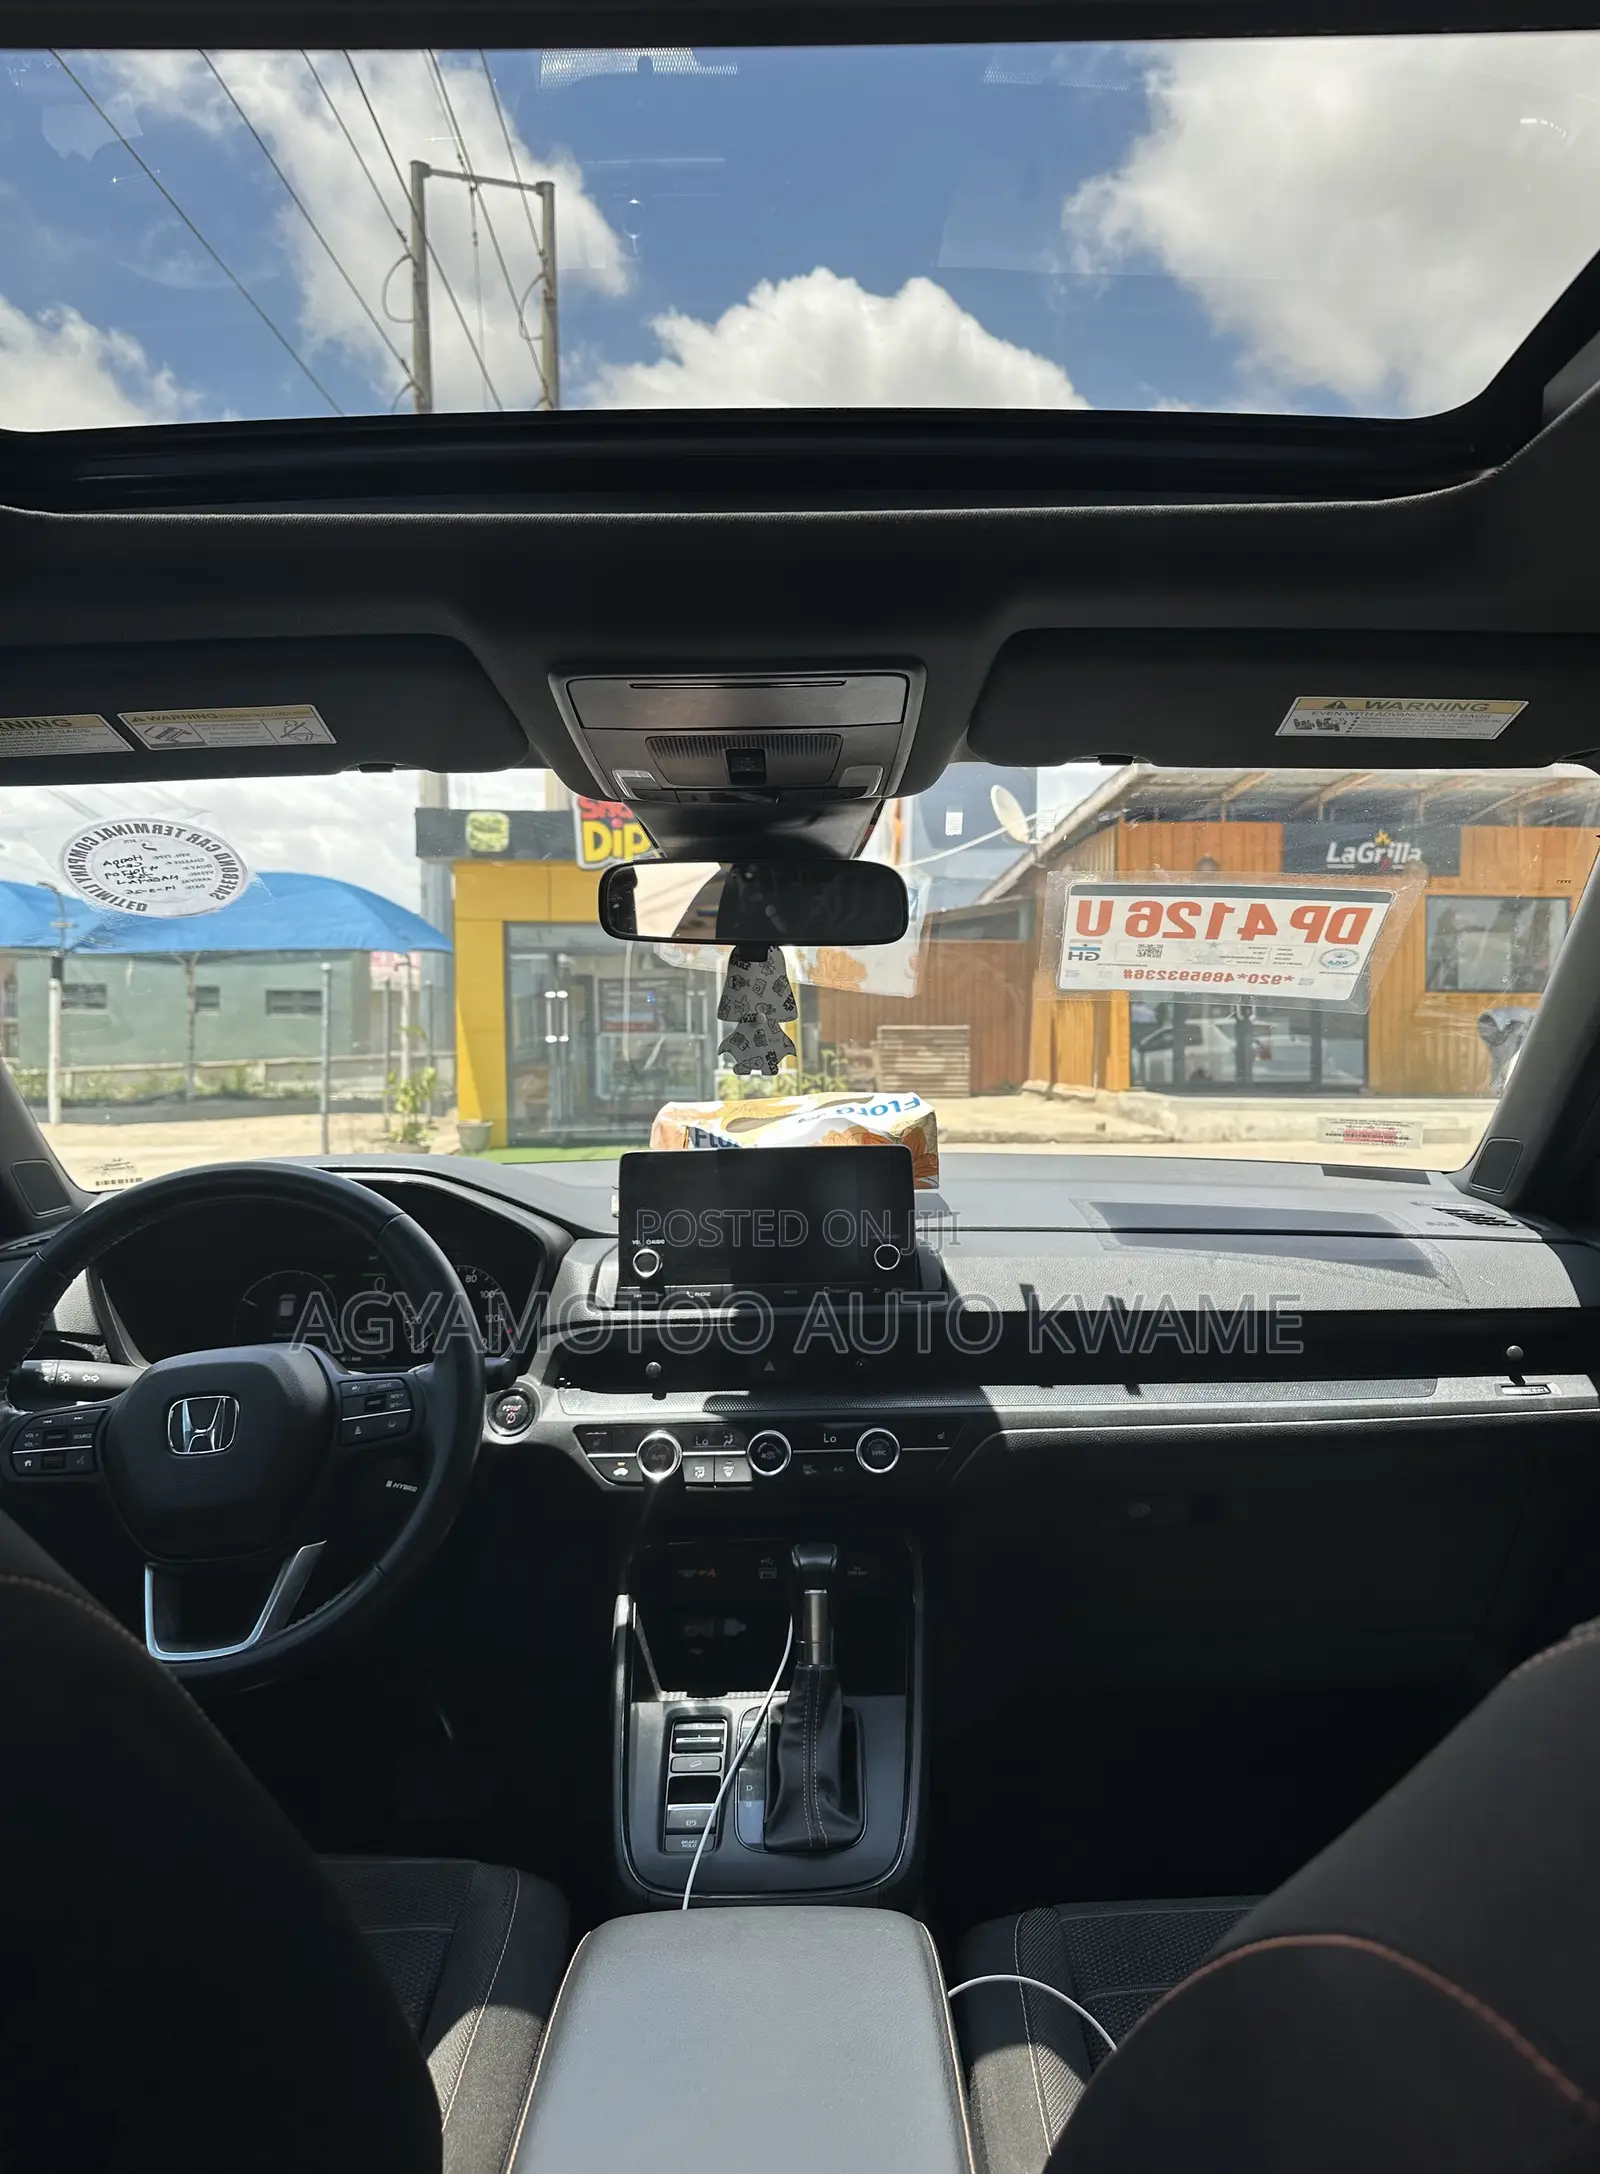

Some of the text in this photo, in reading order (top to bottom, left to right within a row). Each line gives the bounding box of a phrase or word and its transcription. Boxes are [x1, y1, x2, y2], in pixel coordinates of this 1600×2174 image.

[1363, 700, 1491, 712] WARNING
[1325, 840, 1422, 864] LaGrilla
[464, 1274, 478, 1283] 80
[823, 1432, 837, 1443] Lo
